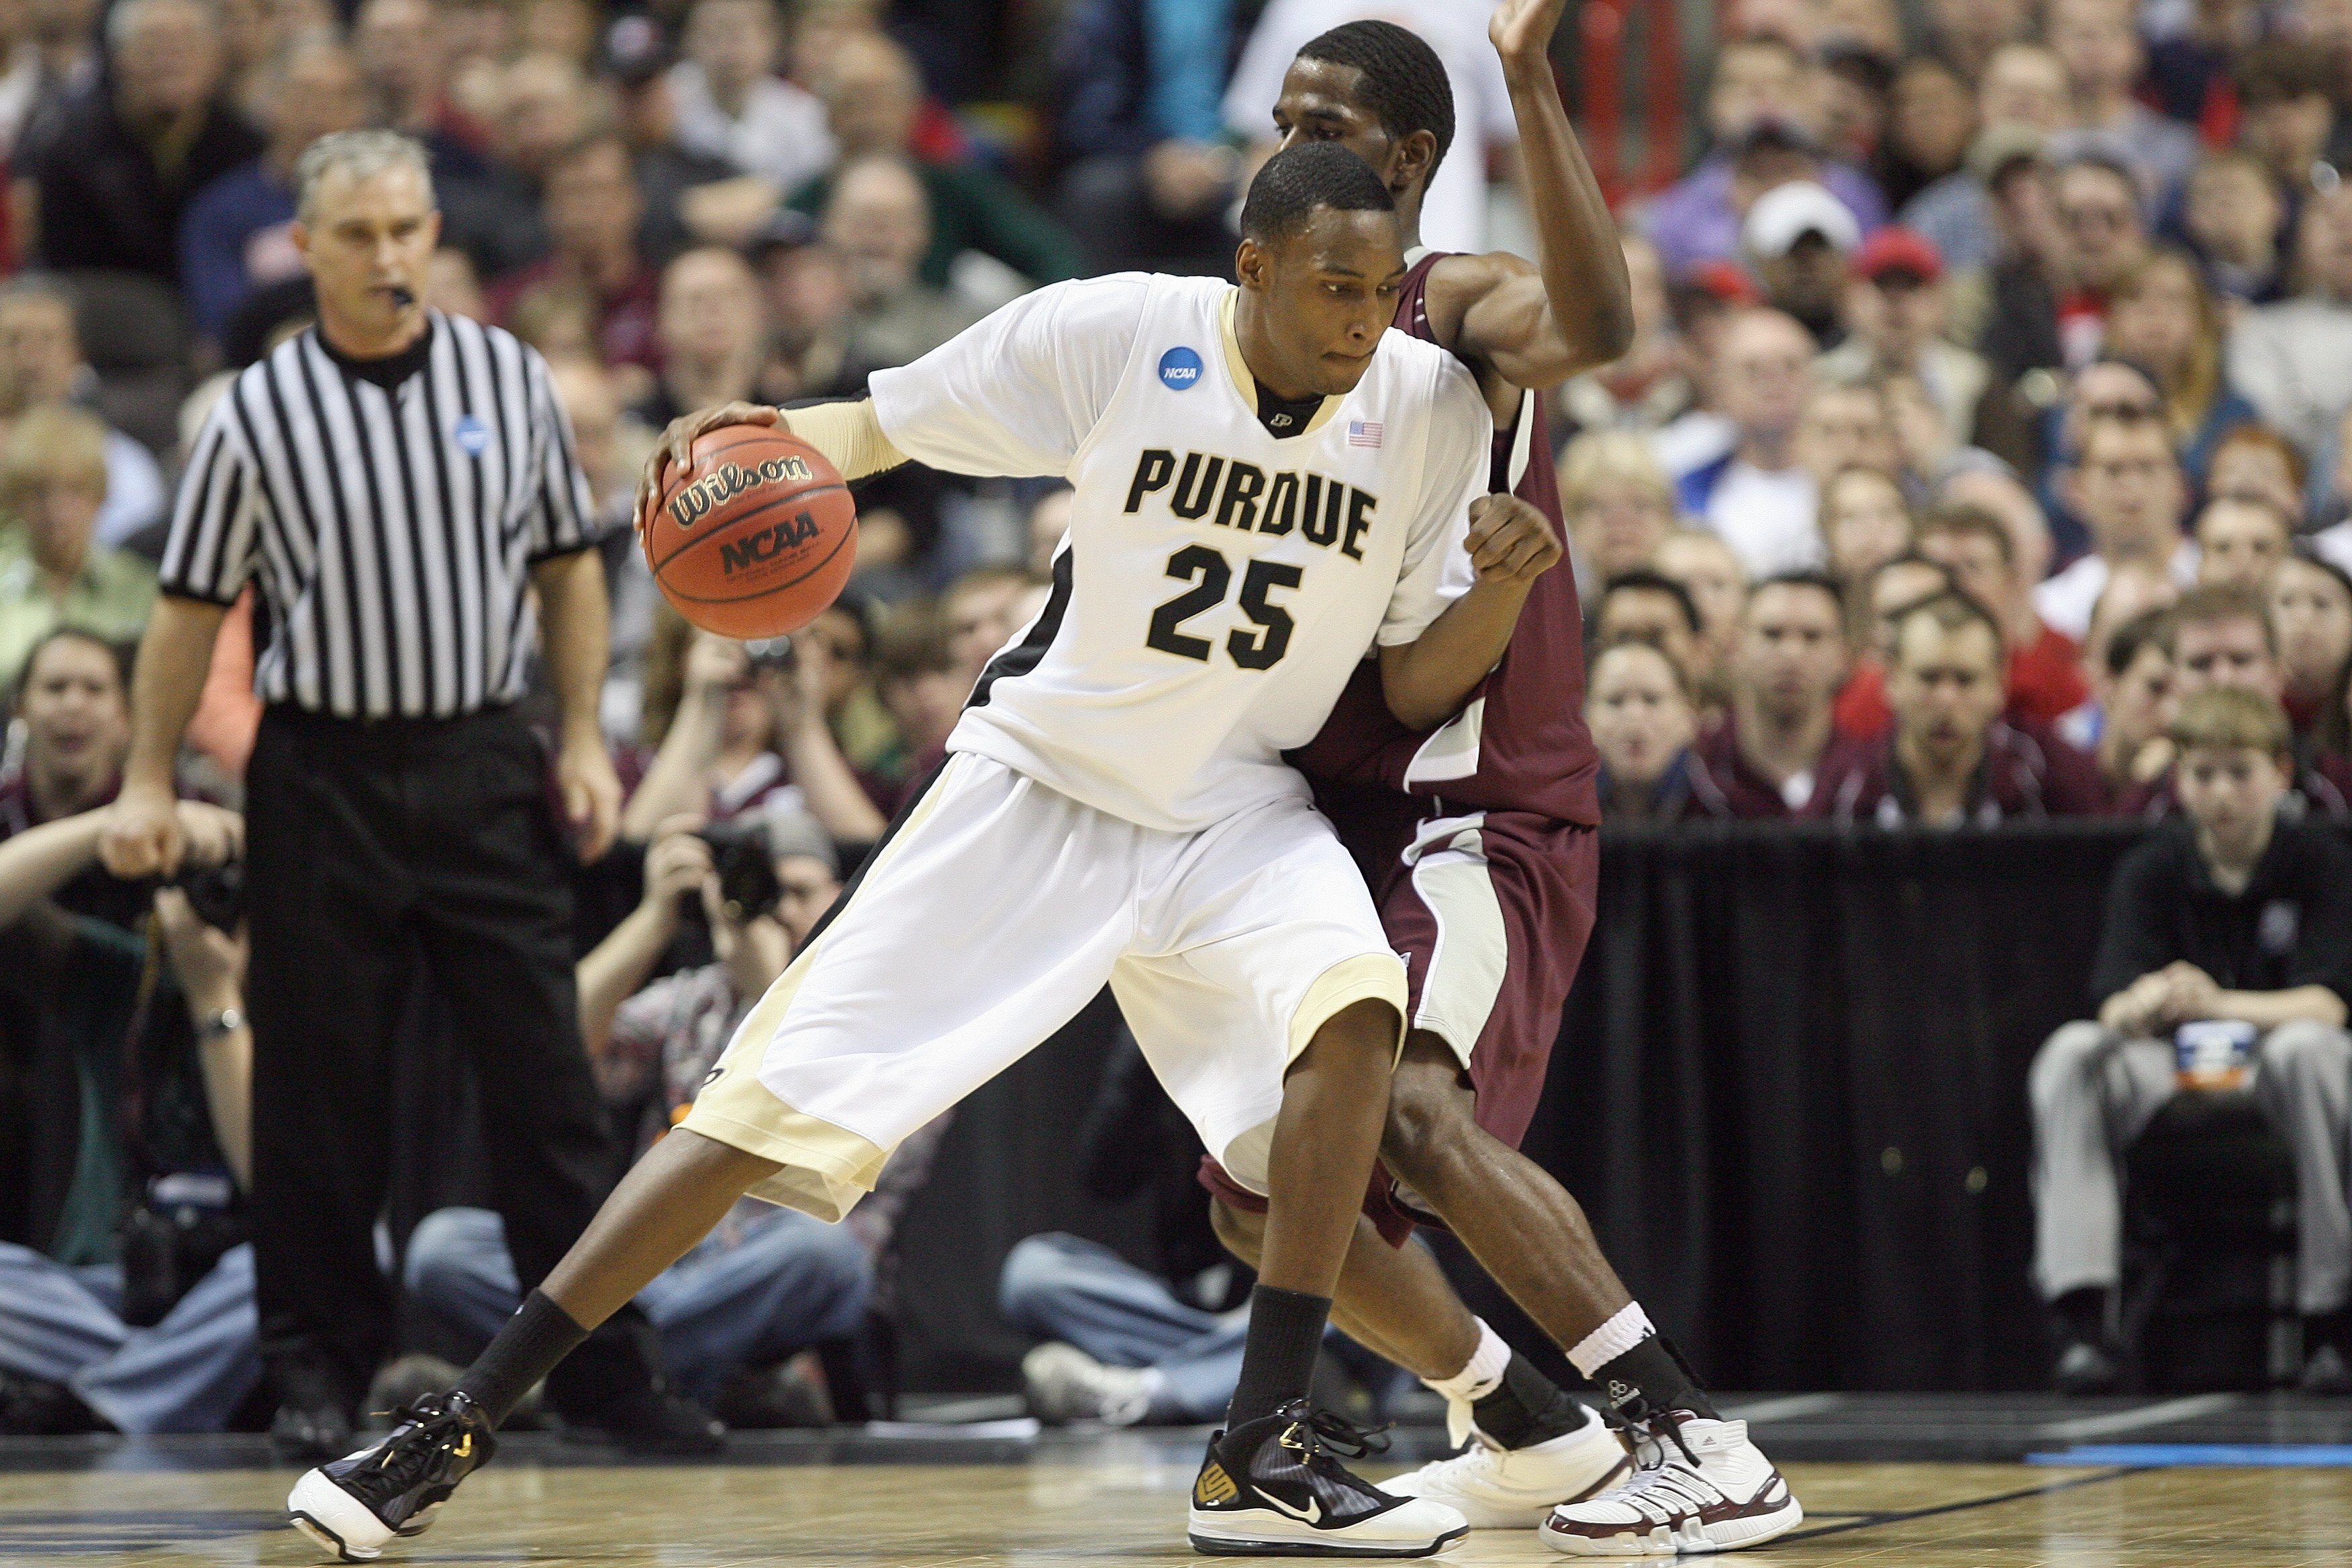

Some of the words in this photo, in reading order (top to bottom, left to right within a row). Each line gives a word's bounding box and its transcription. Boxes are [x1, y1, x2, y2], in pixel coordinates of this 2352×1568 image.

[1164, 367, 1197, 379] NCAA
[667, 455, 814, 530] Wilson
[1123, 448, 1380, 564] PURDUE
[720, 509, 820, 575] NCAA
[1145, 542, 1306, 672] 25
